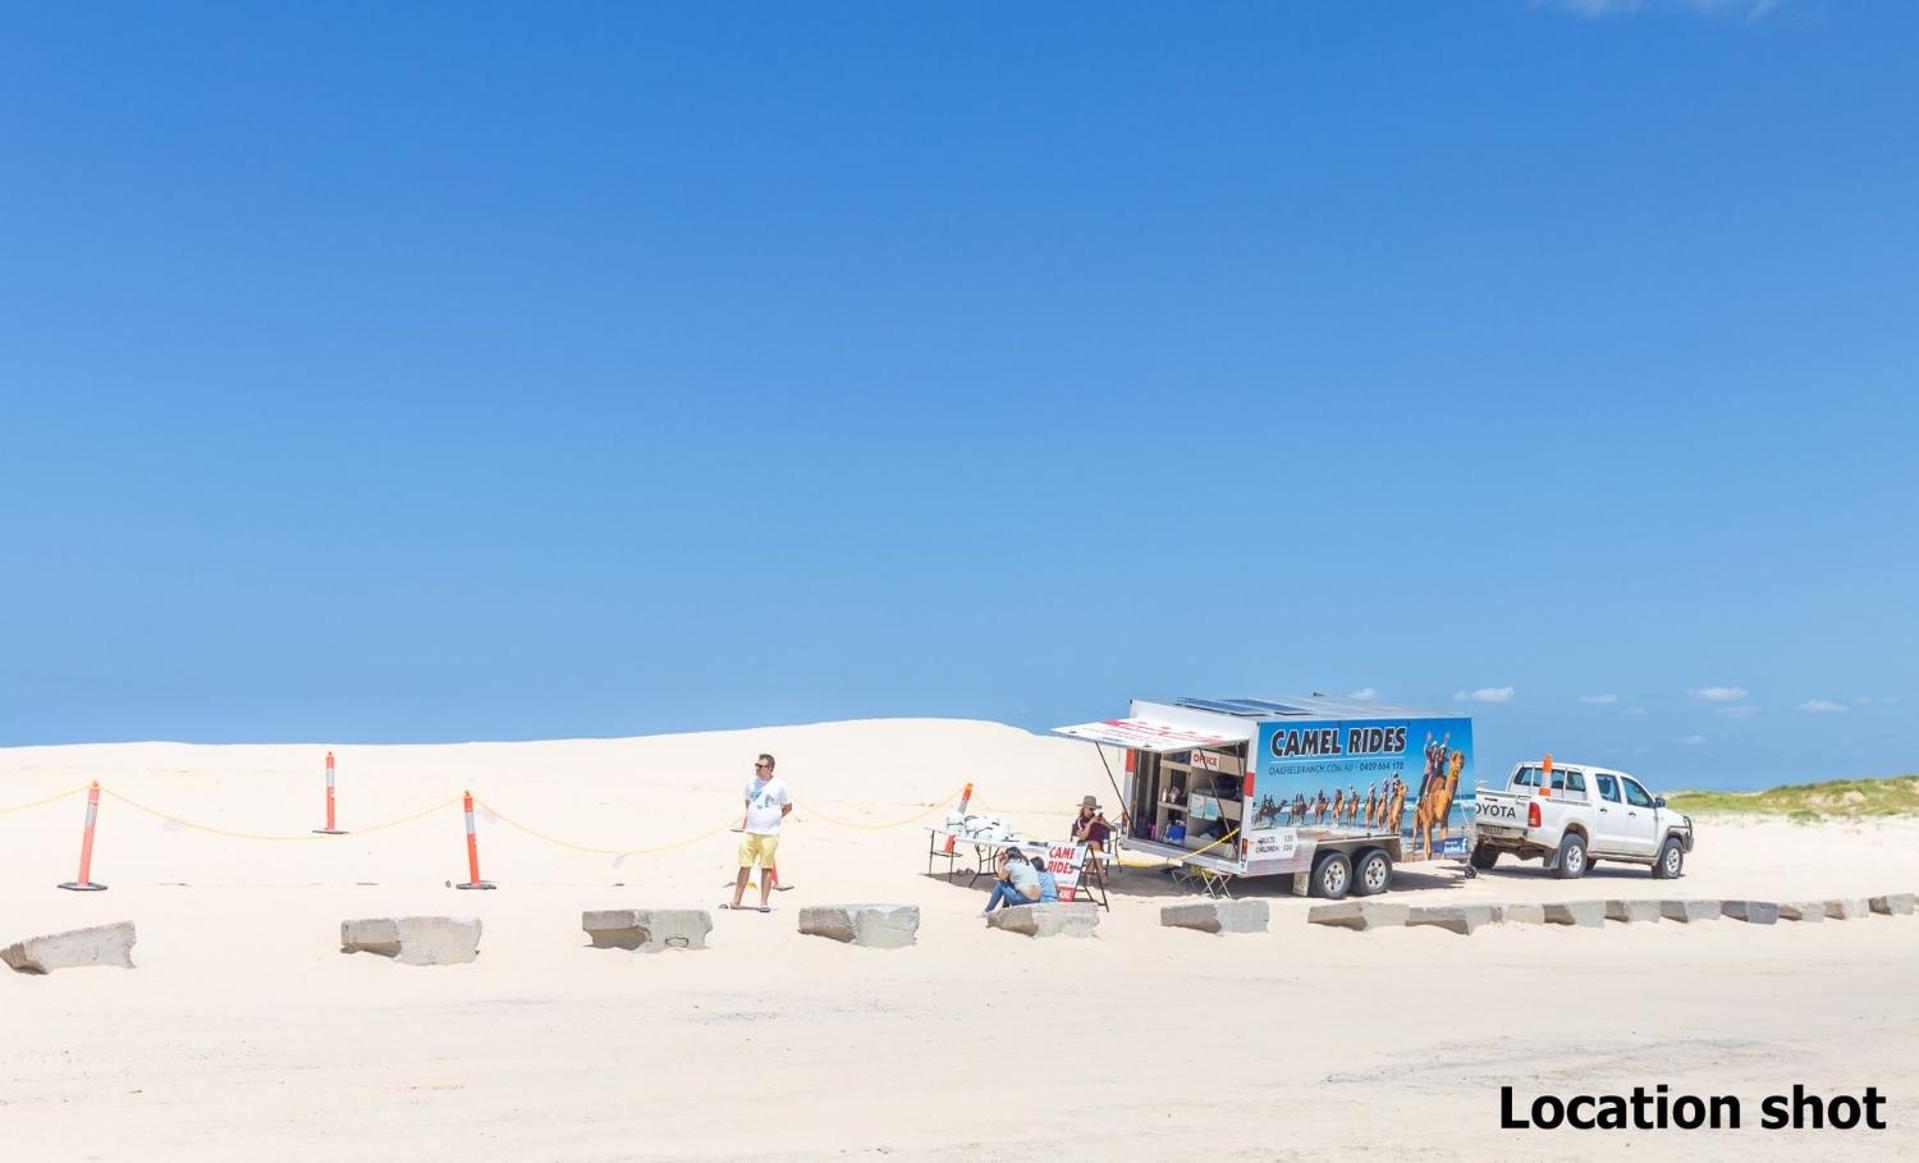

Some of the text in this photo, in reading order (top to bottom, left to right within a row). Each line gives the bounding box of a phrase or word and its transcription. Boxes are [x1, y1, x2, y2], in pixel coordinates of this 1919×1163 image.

[1271, 726, 1407, 758] CAMEL RIDES
[1475, 803, 1516, 818] OYOTA
